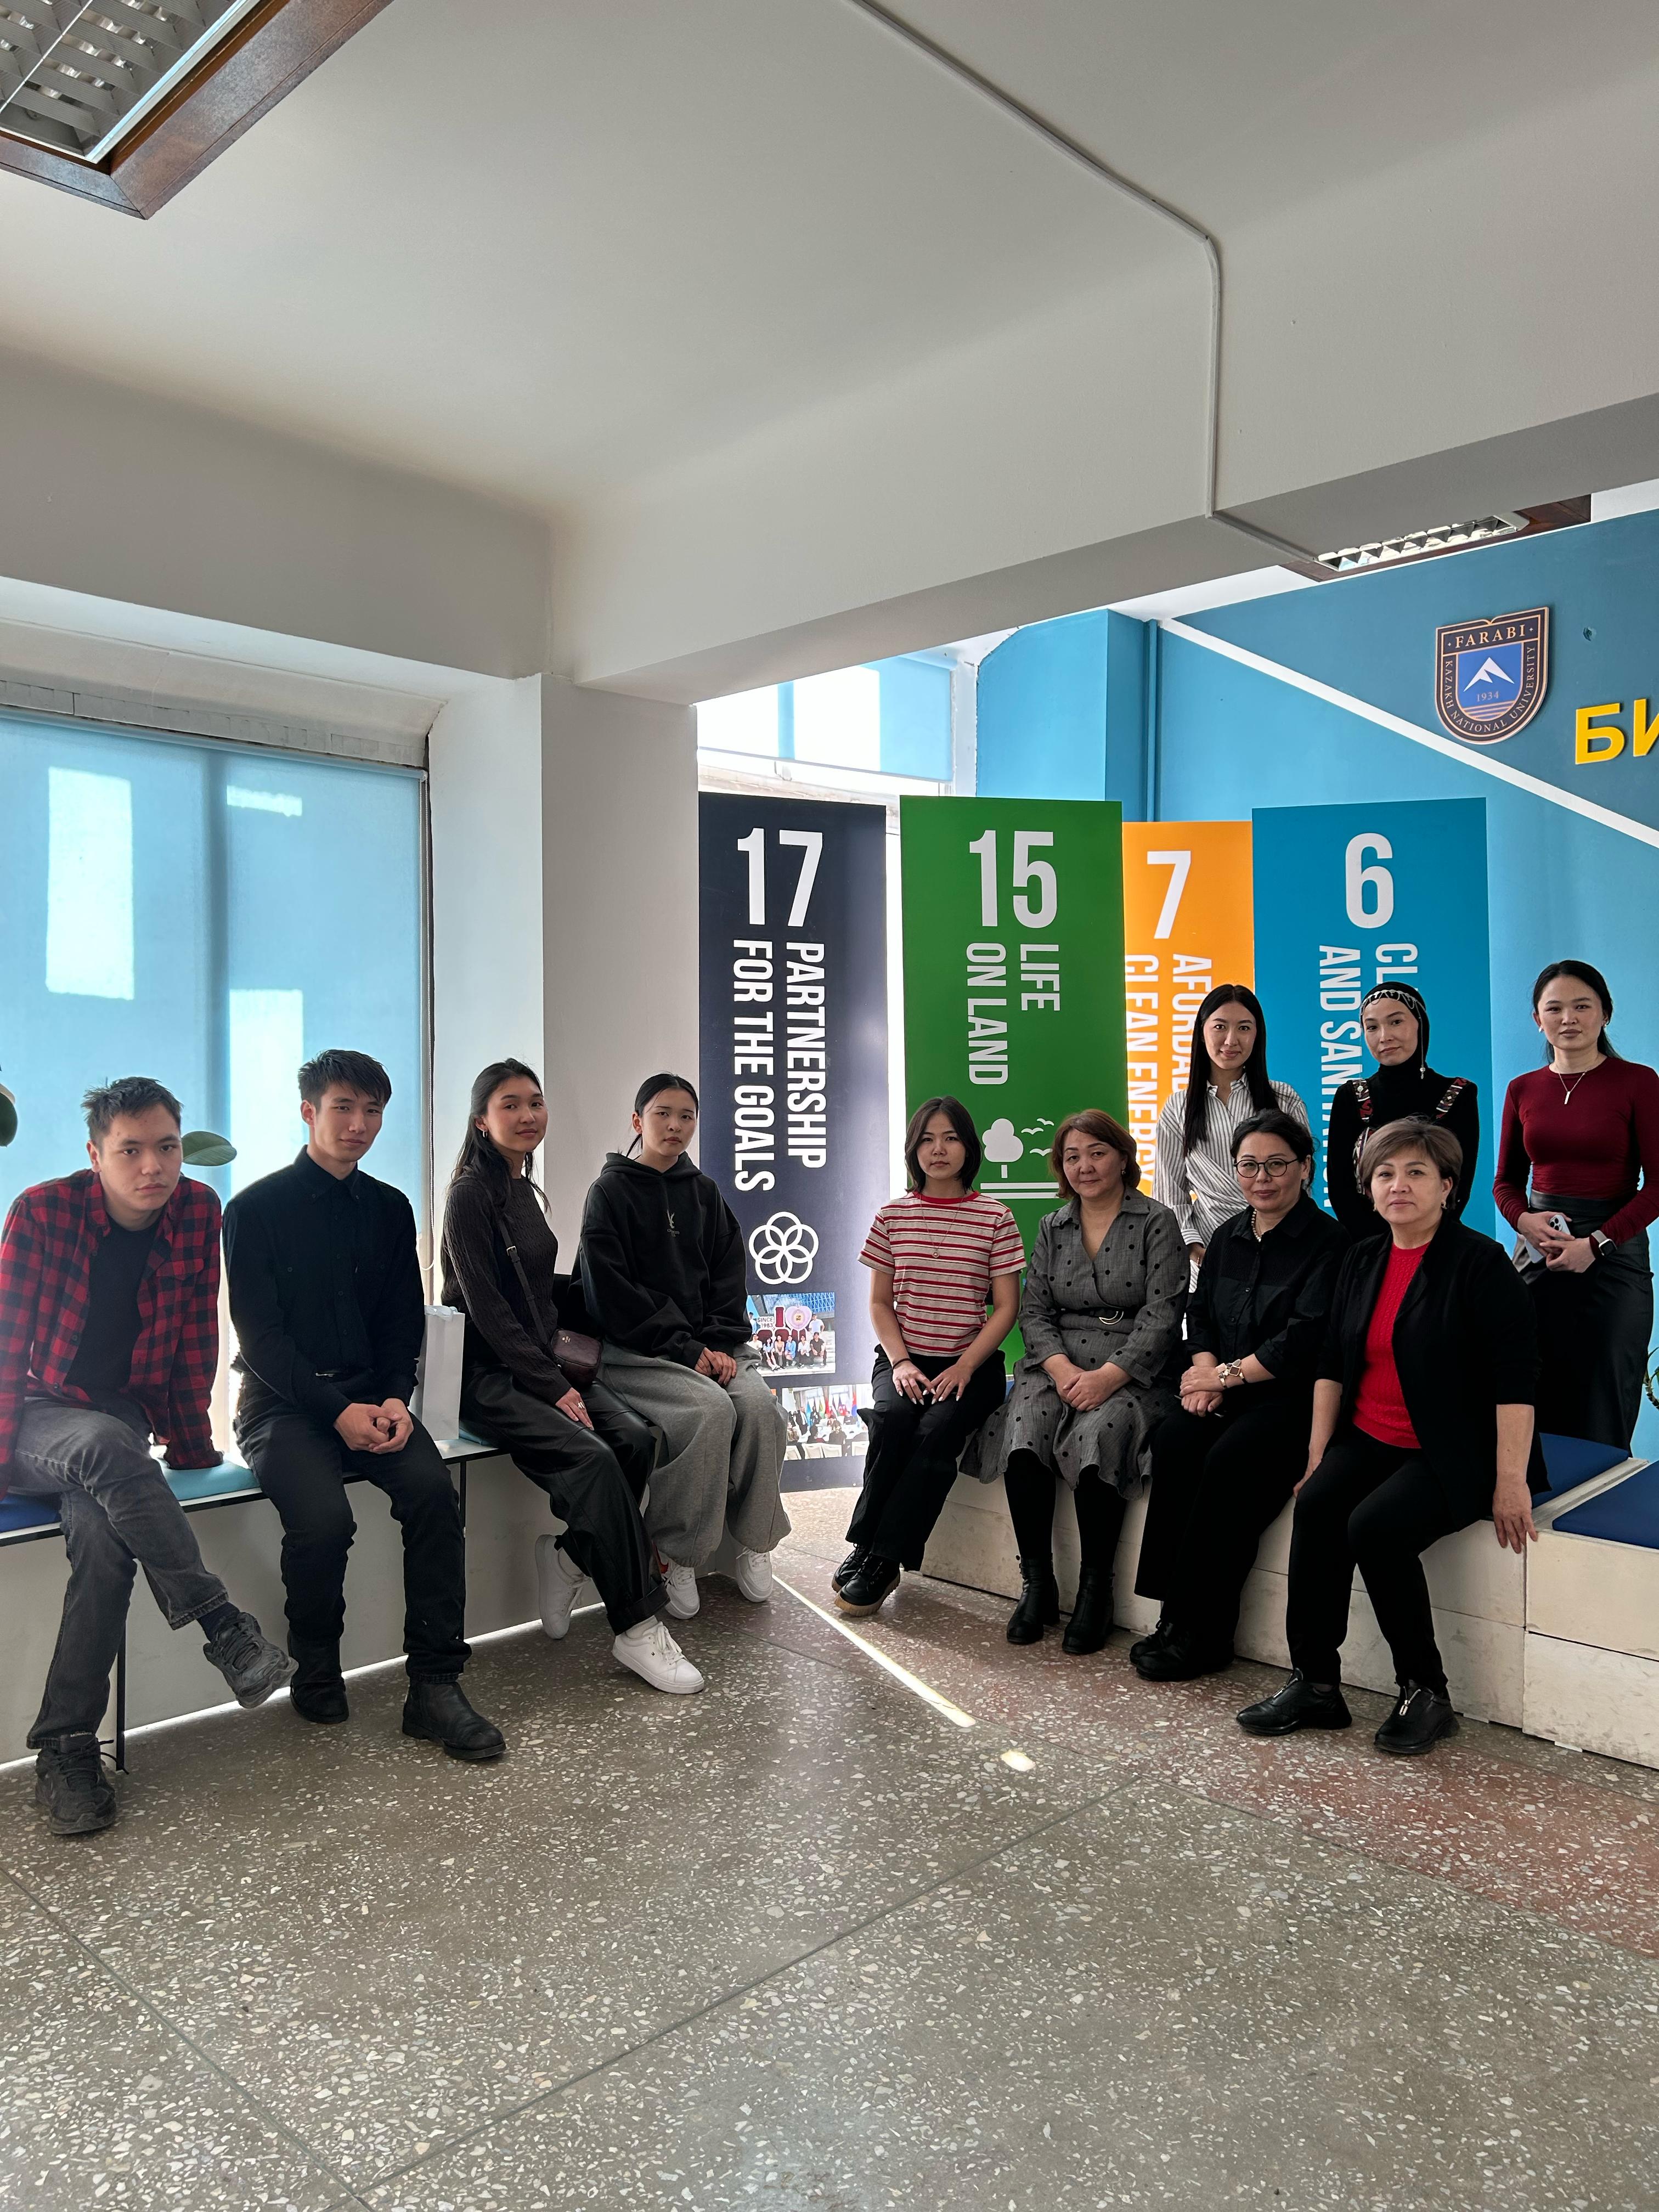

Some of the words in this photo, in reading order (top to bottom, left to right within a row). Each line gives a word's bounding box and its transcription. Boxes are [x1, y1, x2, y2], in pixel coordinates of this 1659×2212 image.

[1455, 624, 1525, 648] FARABI
[1444, 659, 1454, 708] KAZAKH
[1451, 710, 1507, 732] NATIONAL
[1510, 647, 1535, 719] UNIVERSITY
[1477, 691, 1499, 702] 1934
[737, 827, 823, 927] 17
[969, 830, 1058, 929] 15
[1147, 850, 1191, 939] 7
[1345, 832, 1394, 929] 6
[733, 939, 774, 1002] FOR
[966, 942, 1006, 987] ON
[1020, 944, 1060, 1011] LIFE
[1319, 945, 1361, 1011] AND
[733, 1012, 774, 1076] THE
[786, 942, 827, 1169] PARTNERSHIP
[968, 998, 1008, 1085] LAND
[734, 1085, 775, 1192] GOALS
